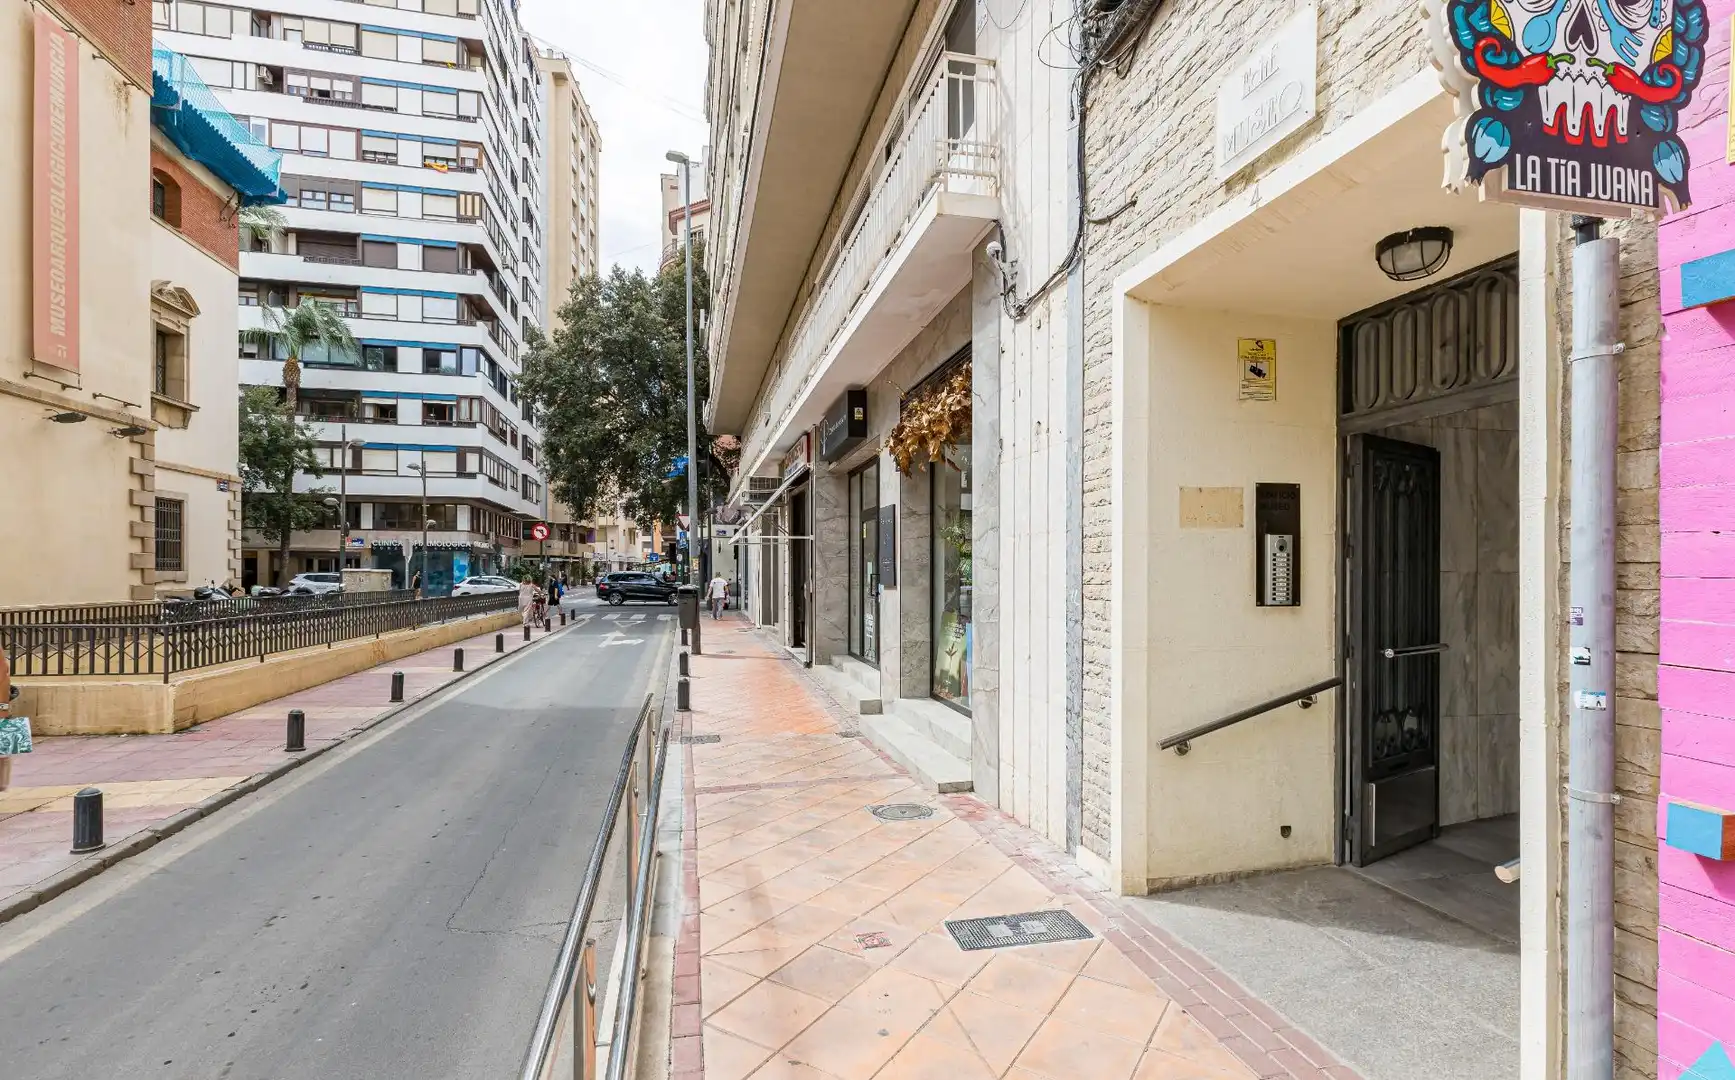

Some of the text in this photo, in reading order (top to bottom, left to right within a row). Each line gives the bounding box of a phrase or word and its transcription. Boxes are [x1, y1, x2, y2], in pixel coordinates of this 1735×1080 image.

[1223, 80, 1303, 161] MUSEO
[1515, 153, 1541, 192] LA
[1587, 163, 1654, 206] JUANA
